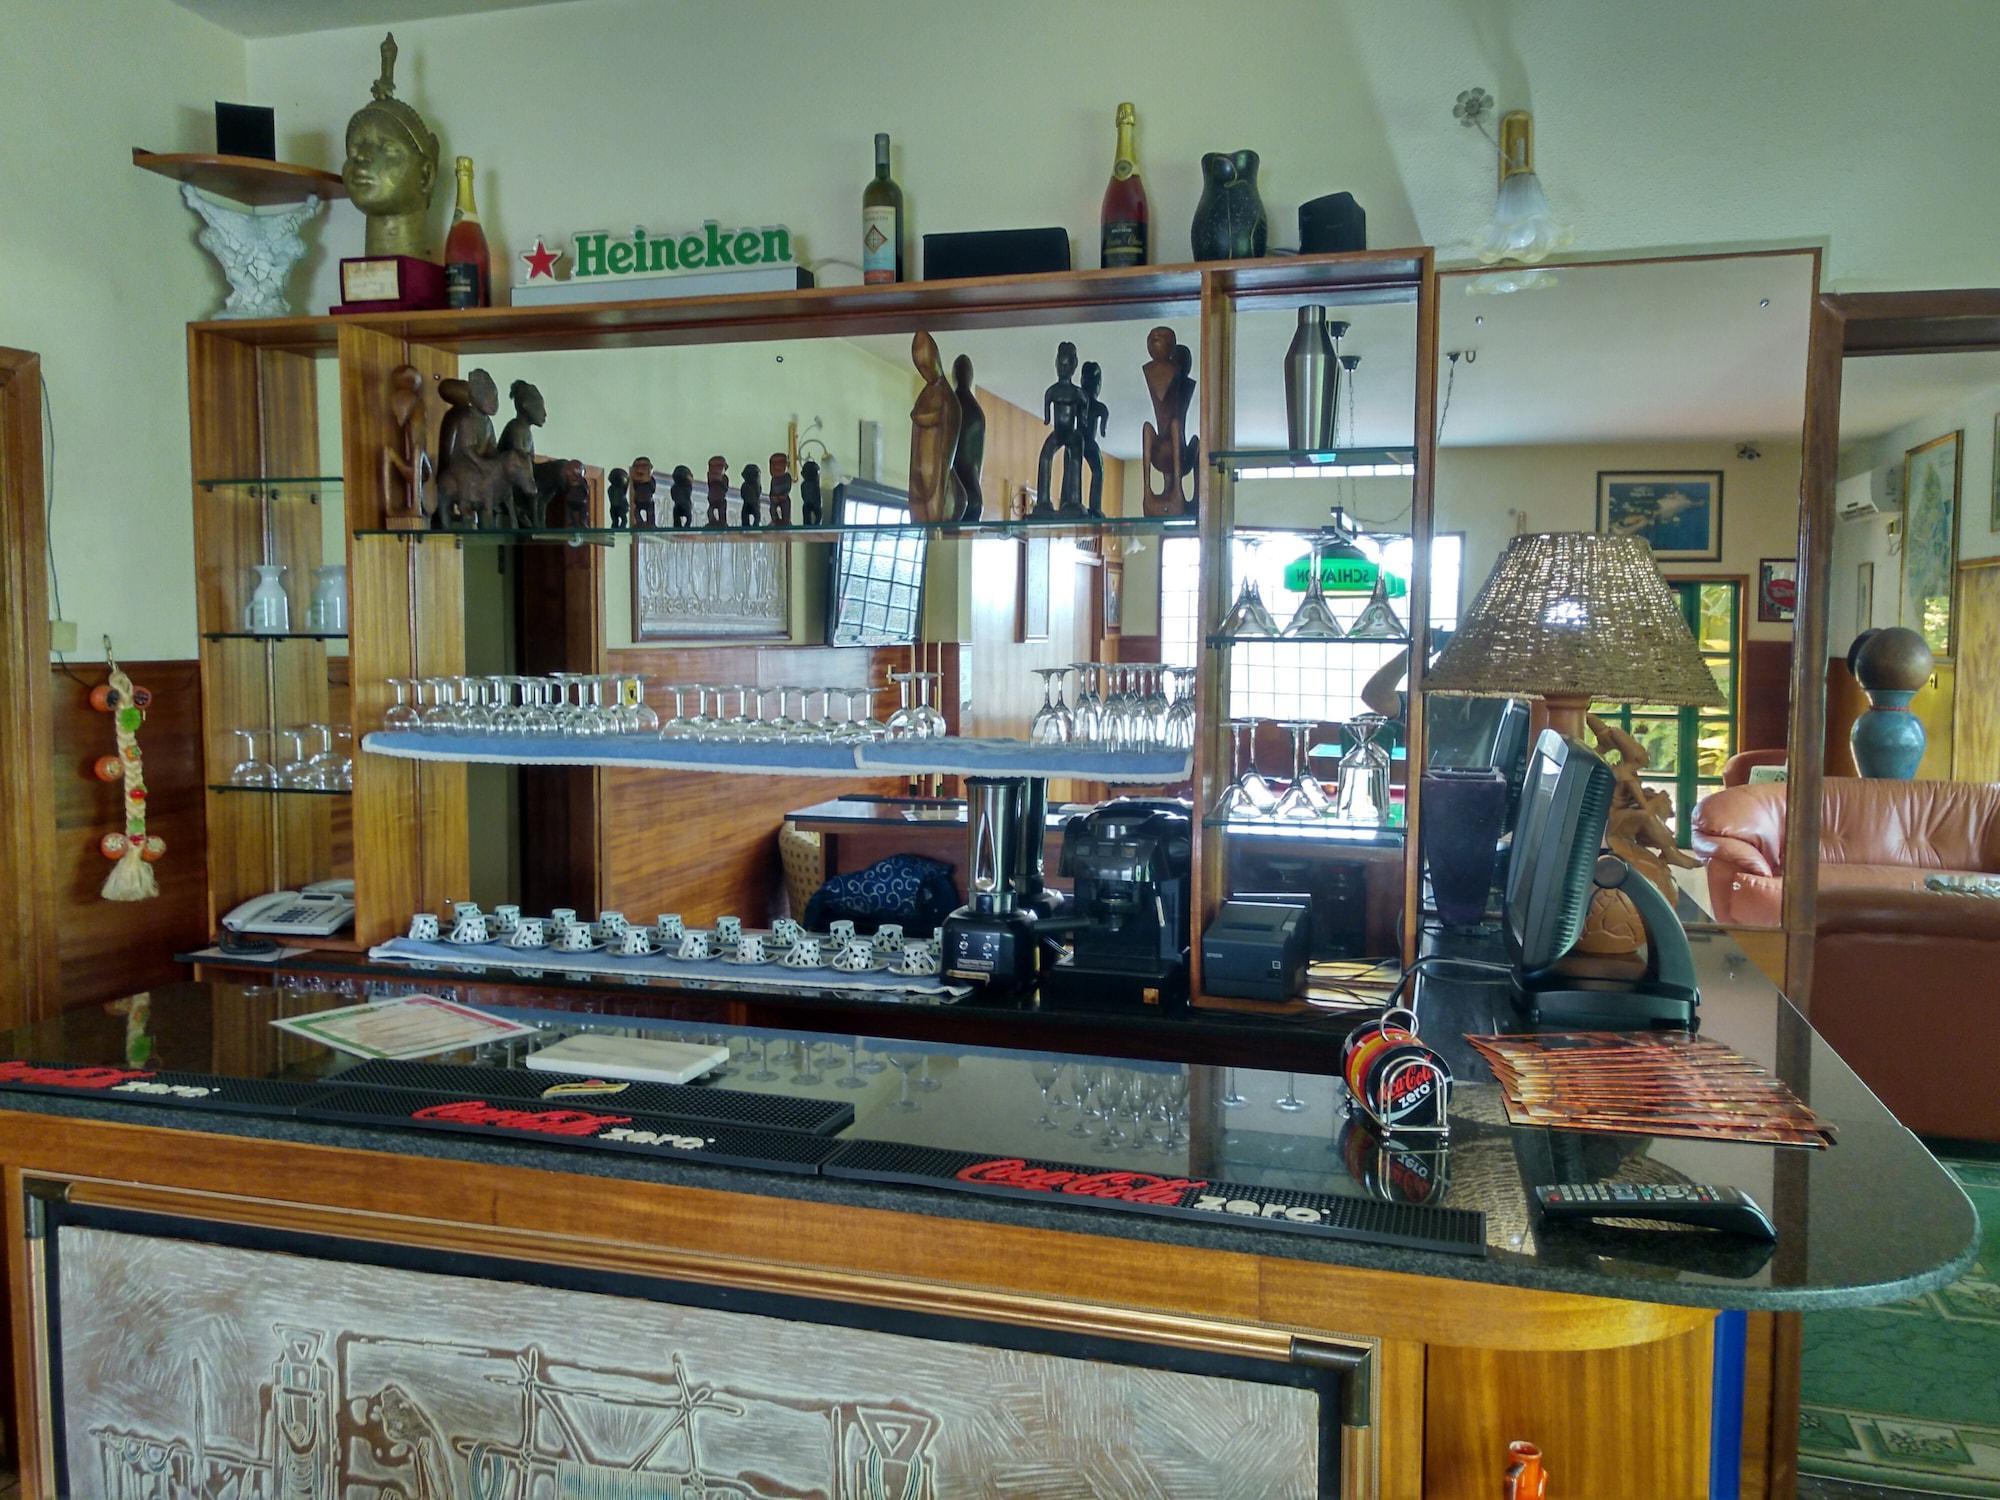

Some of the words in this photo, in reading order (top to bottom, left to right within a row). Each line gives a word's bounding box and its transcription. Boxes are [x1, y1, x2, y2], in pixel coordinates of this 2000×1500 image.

[575, 225, 792, 277] Heineken
[1398, 1083, 1430, 1109] zero
[955, 1159, 1207, 1205] Coca-Cola
[1193, 1194, 1321, 1222] zero
